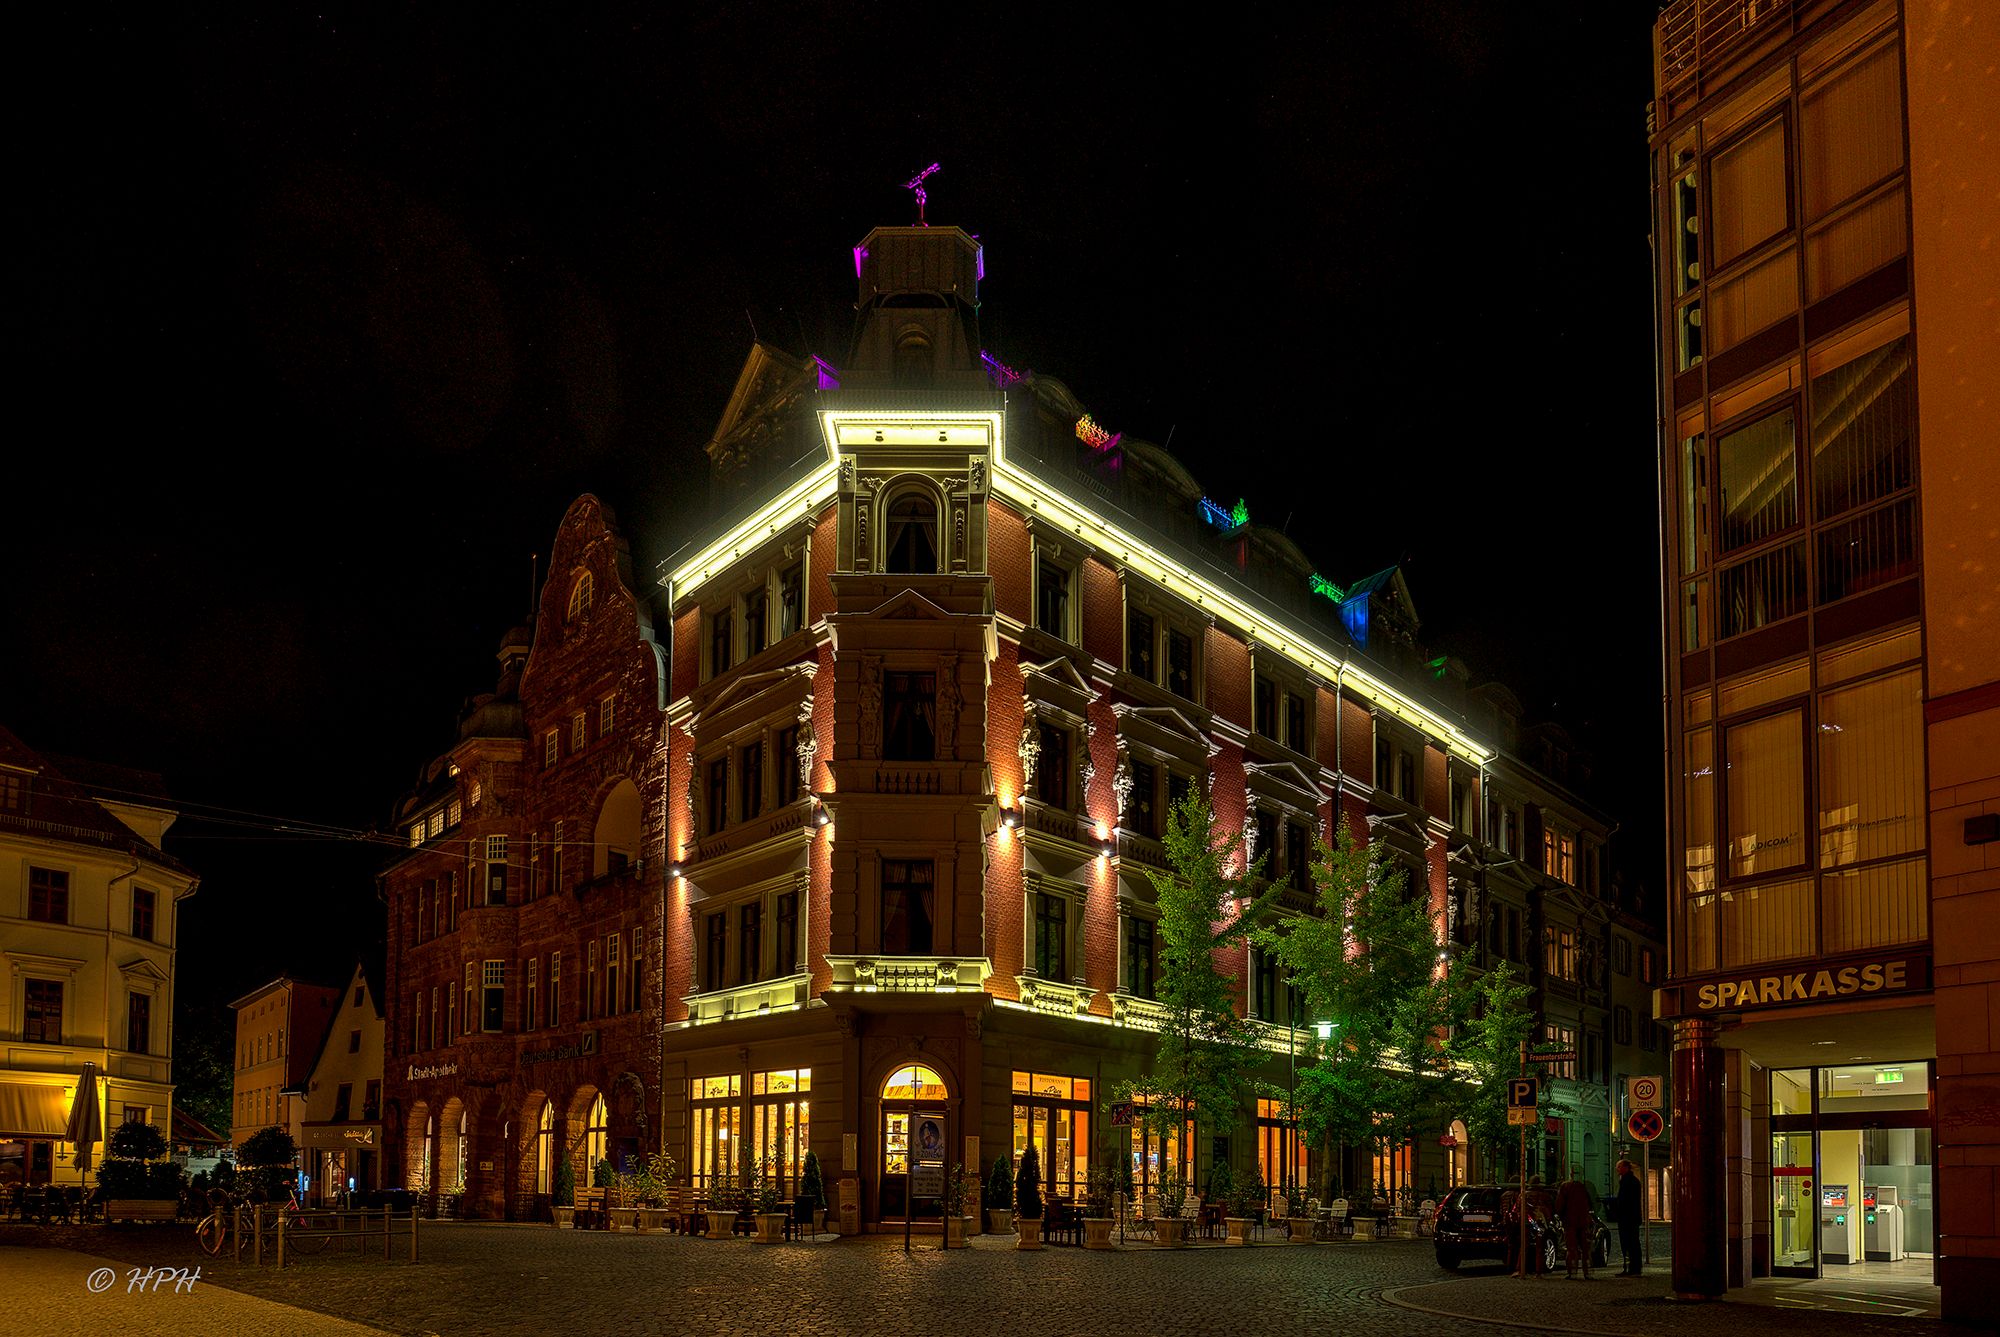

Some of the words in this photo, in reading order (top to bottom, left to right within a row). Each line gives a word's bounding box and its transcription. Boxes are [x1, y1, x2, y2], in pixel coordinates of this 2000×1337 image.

[1698, 960, 1907, 1010] SPARKASSE
[558, 1042, 580, 1060] Bank
[1514, 1083, 1531, 1105] P
[1639, 1085, 1652, 1095] 20
